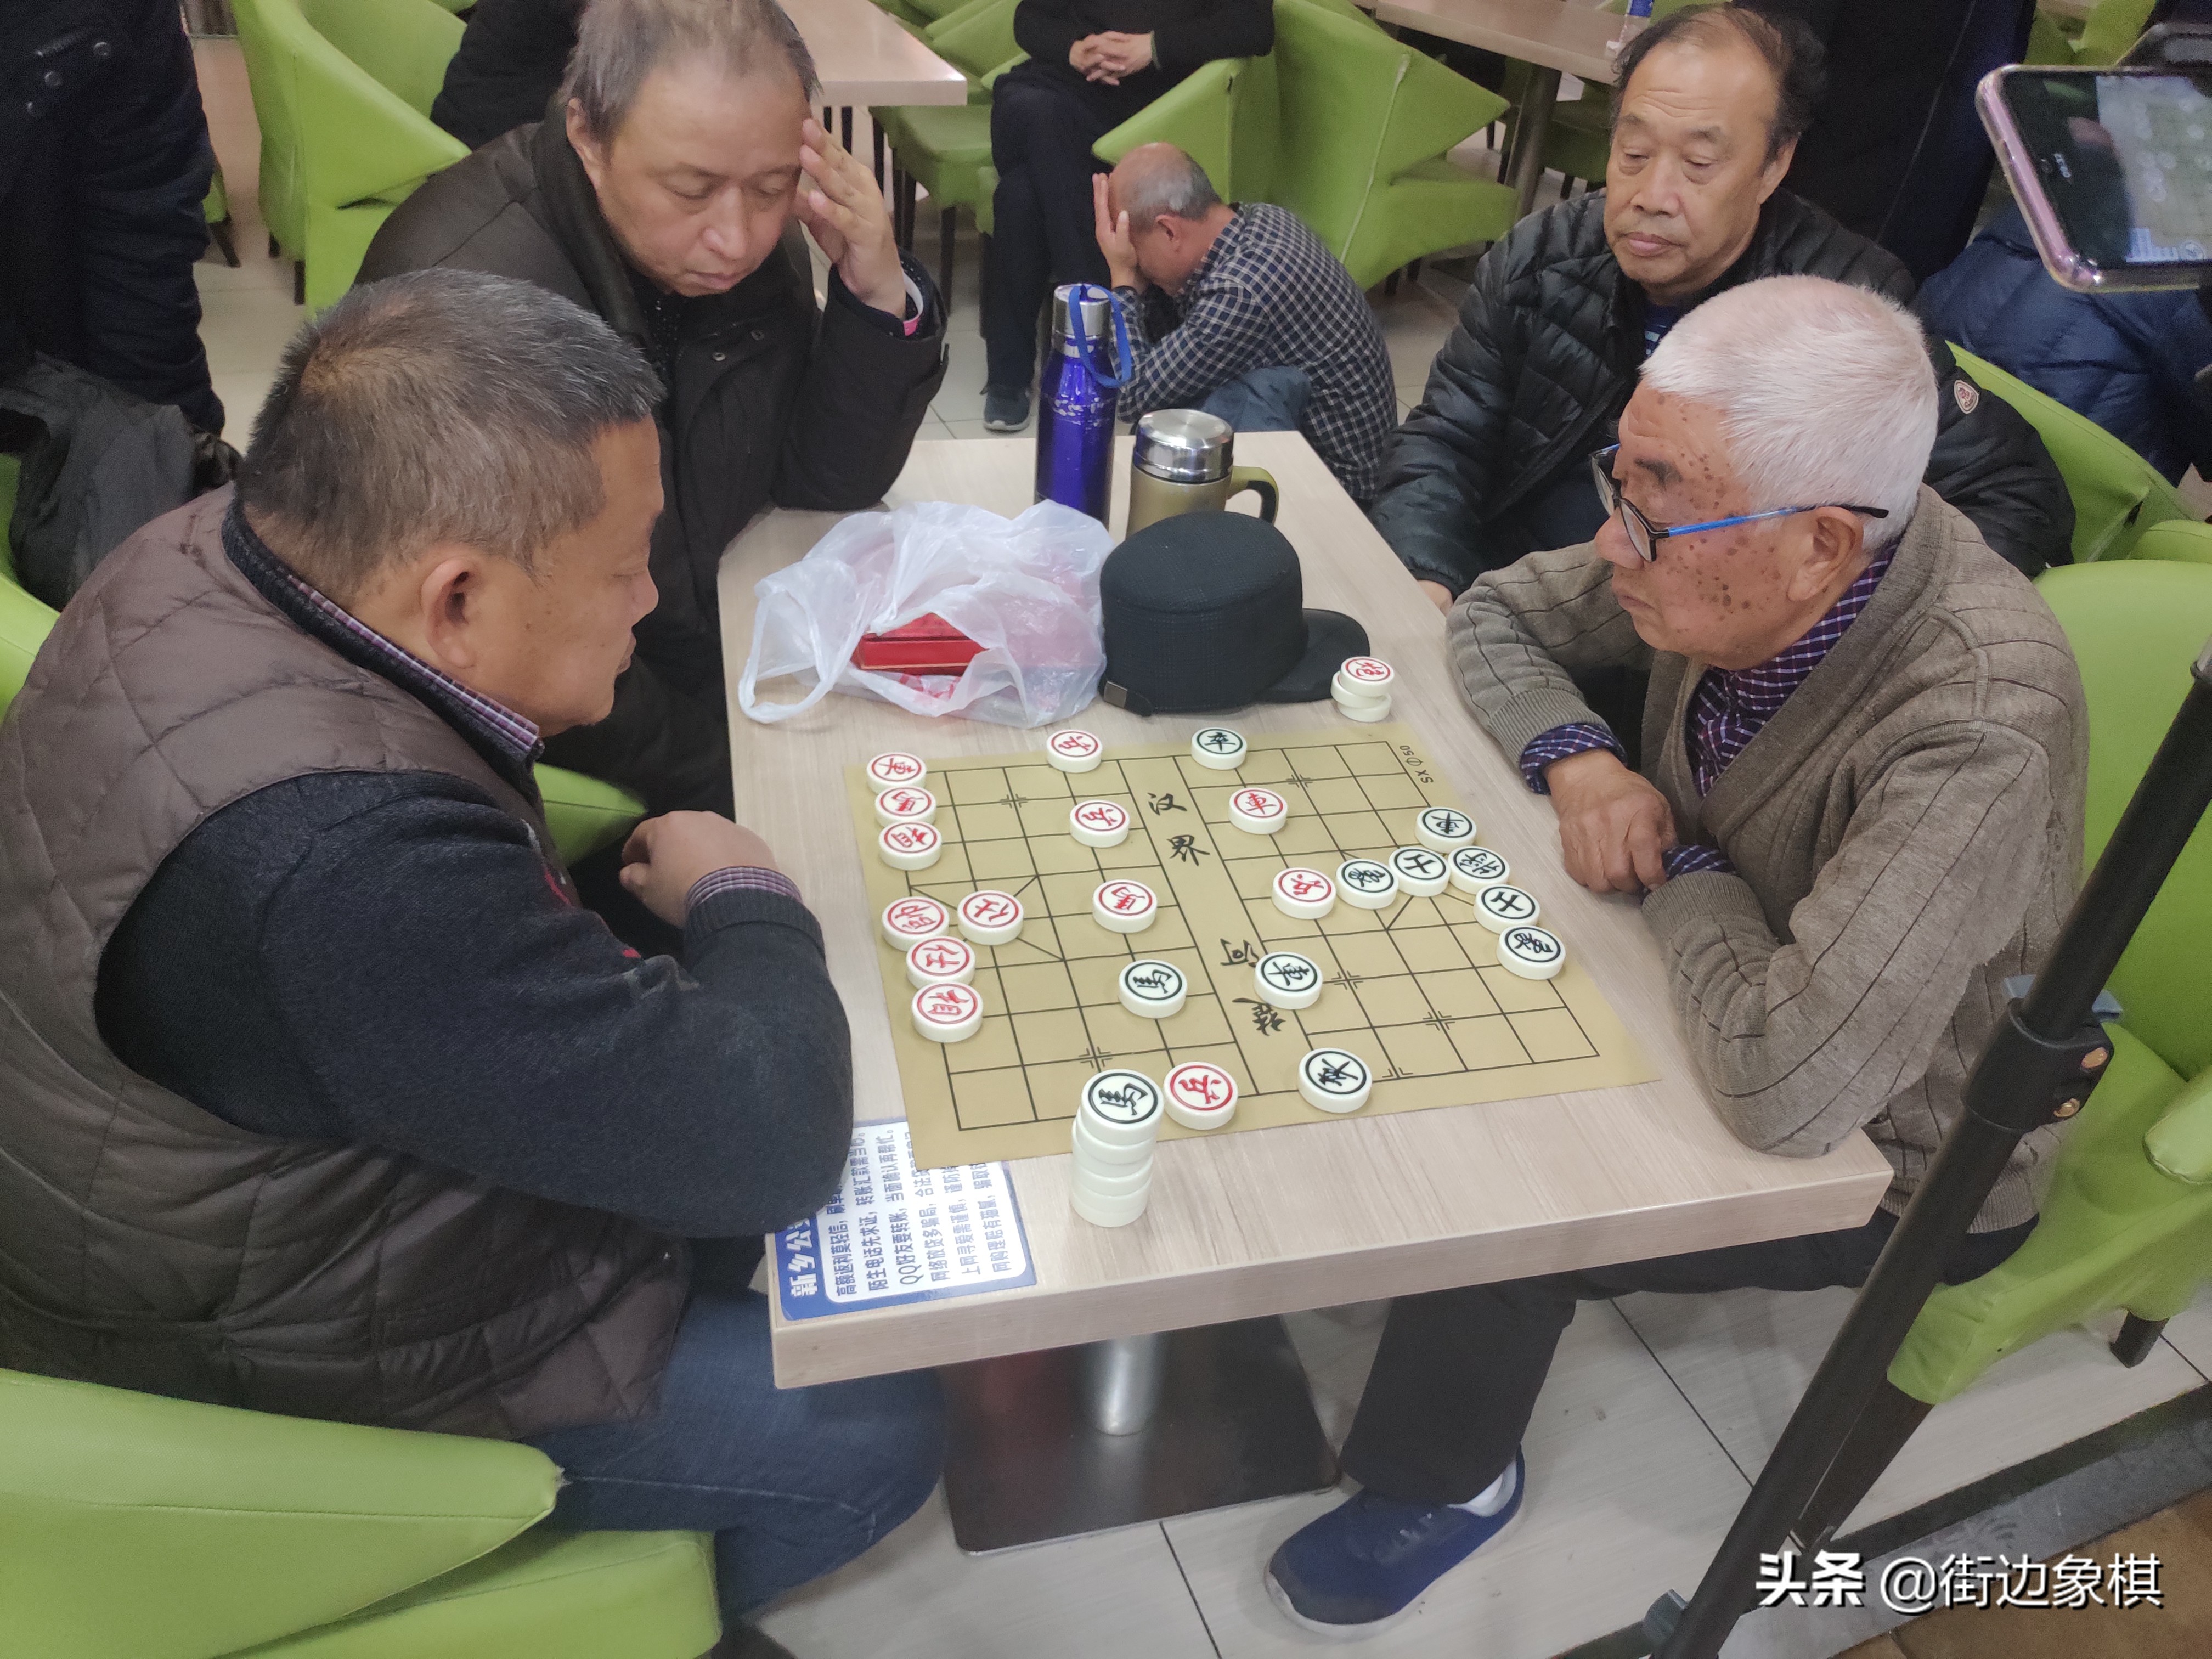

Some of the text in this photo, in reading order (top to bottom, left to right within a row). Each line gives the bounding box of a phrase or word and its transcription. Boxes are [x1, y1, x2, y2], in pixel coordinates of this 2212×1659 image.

[1058, 736, 1091, 751] 兵
[1204, 732, 1235, 751] 卒
[1082, 808, 1117, 826] 兵
[892, 827, 927, 848] 相
[1403, 854, 1437, 874] 士
[1293, 874, 1324, 896] 兵
[1348, 868, 1386, 888] 象
[974, 899, 1009, 922] 仕
[1490, 891, 1525, 912] 士
[1514, 933, 1553, 953] 象
[924, 945, 960, 968] 仕
[928, 990, 969, 1015] 相
[1317, 1059, 1358, 1086] 卒
[1180, 1075, 1222, 1104] 兵
[785, 1217, 819, 1298] 新乡公
